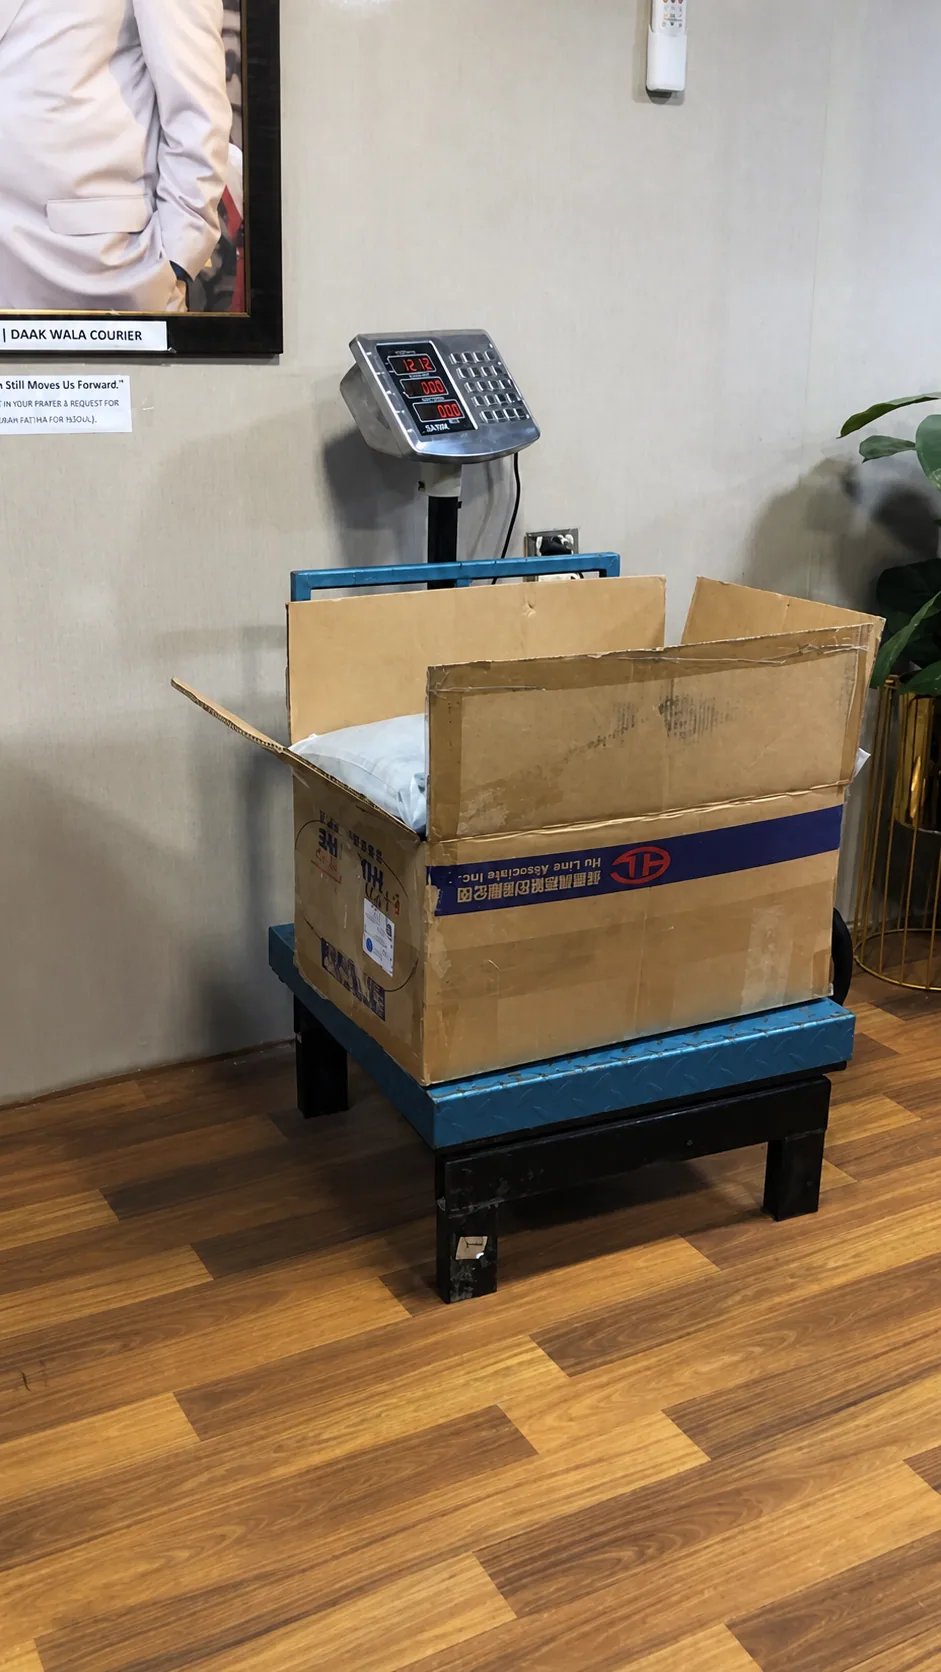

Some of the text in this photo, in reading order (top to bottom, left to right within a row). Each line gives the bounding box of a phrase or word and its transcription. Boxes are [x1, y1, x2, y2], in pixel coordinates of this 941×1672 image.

[11, 329, 47, 340] DAAK
[50, 329, 87, 340] WALA
[90, 330, 142, 341] COURIER
[5, 380, 25, 389] Still
[27, 380, 60, 390] Moves
[62, 380, 76, 390] Us
[3, 400, 12, 408] IN
[71, 400, 102, 408] REQUEST
[104, 399, 120, 407] FOR
[553, 859, 581, 873] Line
[584, 857, 602, 871] Hu
[457, 873, 484, 884] Inc.
